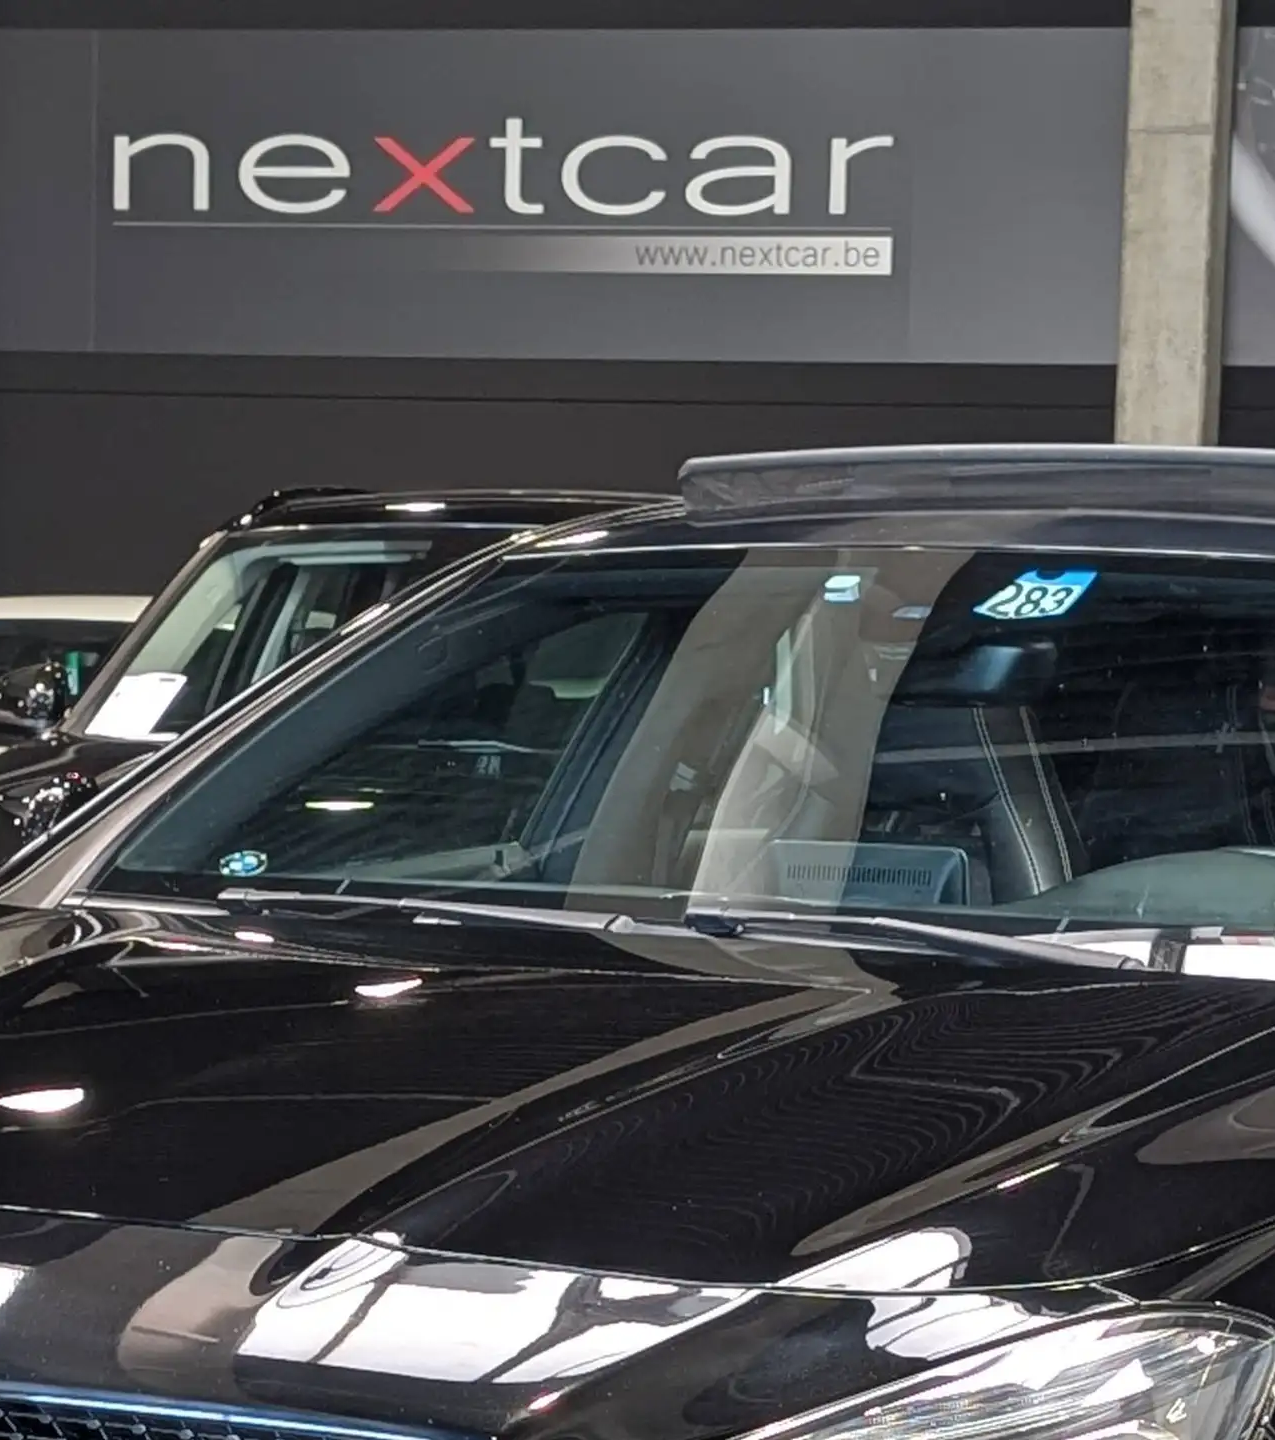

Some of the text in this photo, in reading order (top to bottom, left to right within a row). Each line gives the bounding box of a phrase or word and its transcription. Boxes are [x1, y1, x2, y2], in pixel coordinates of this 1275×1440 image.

[111, 117, 895, 216] nextcar
[633, 238, 882, 271] www.nextcar.be
[986, 582, 1074, 617] 283
